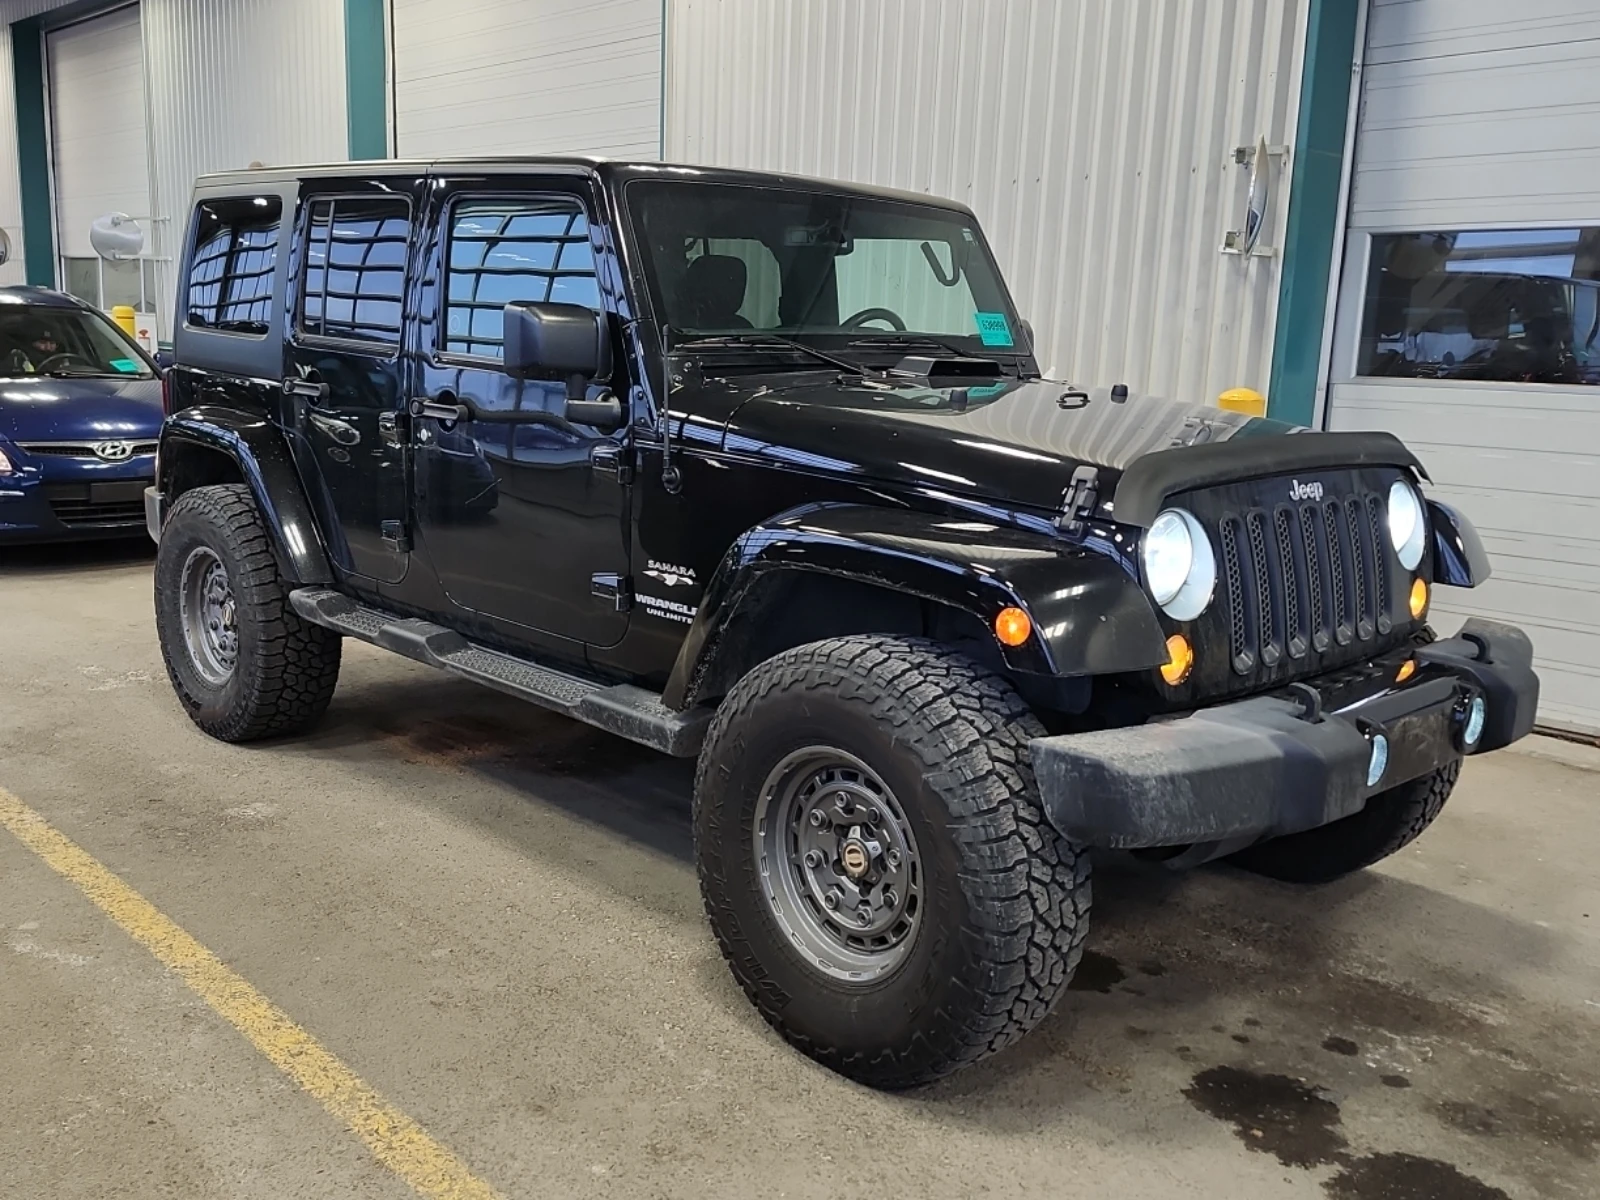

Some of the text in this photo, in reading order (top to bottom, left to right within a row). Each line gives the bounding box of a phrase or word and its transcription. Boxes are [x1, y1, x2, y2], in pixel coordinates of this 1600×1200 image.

[1289, 479, 1324, 502] Jeep
[647, 559, 696, 578] SAHARA
[634, 593, 698, 615] WRANGLE
[646, 607, 694, 624] UNLIMITE
